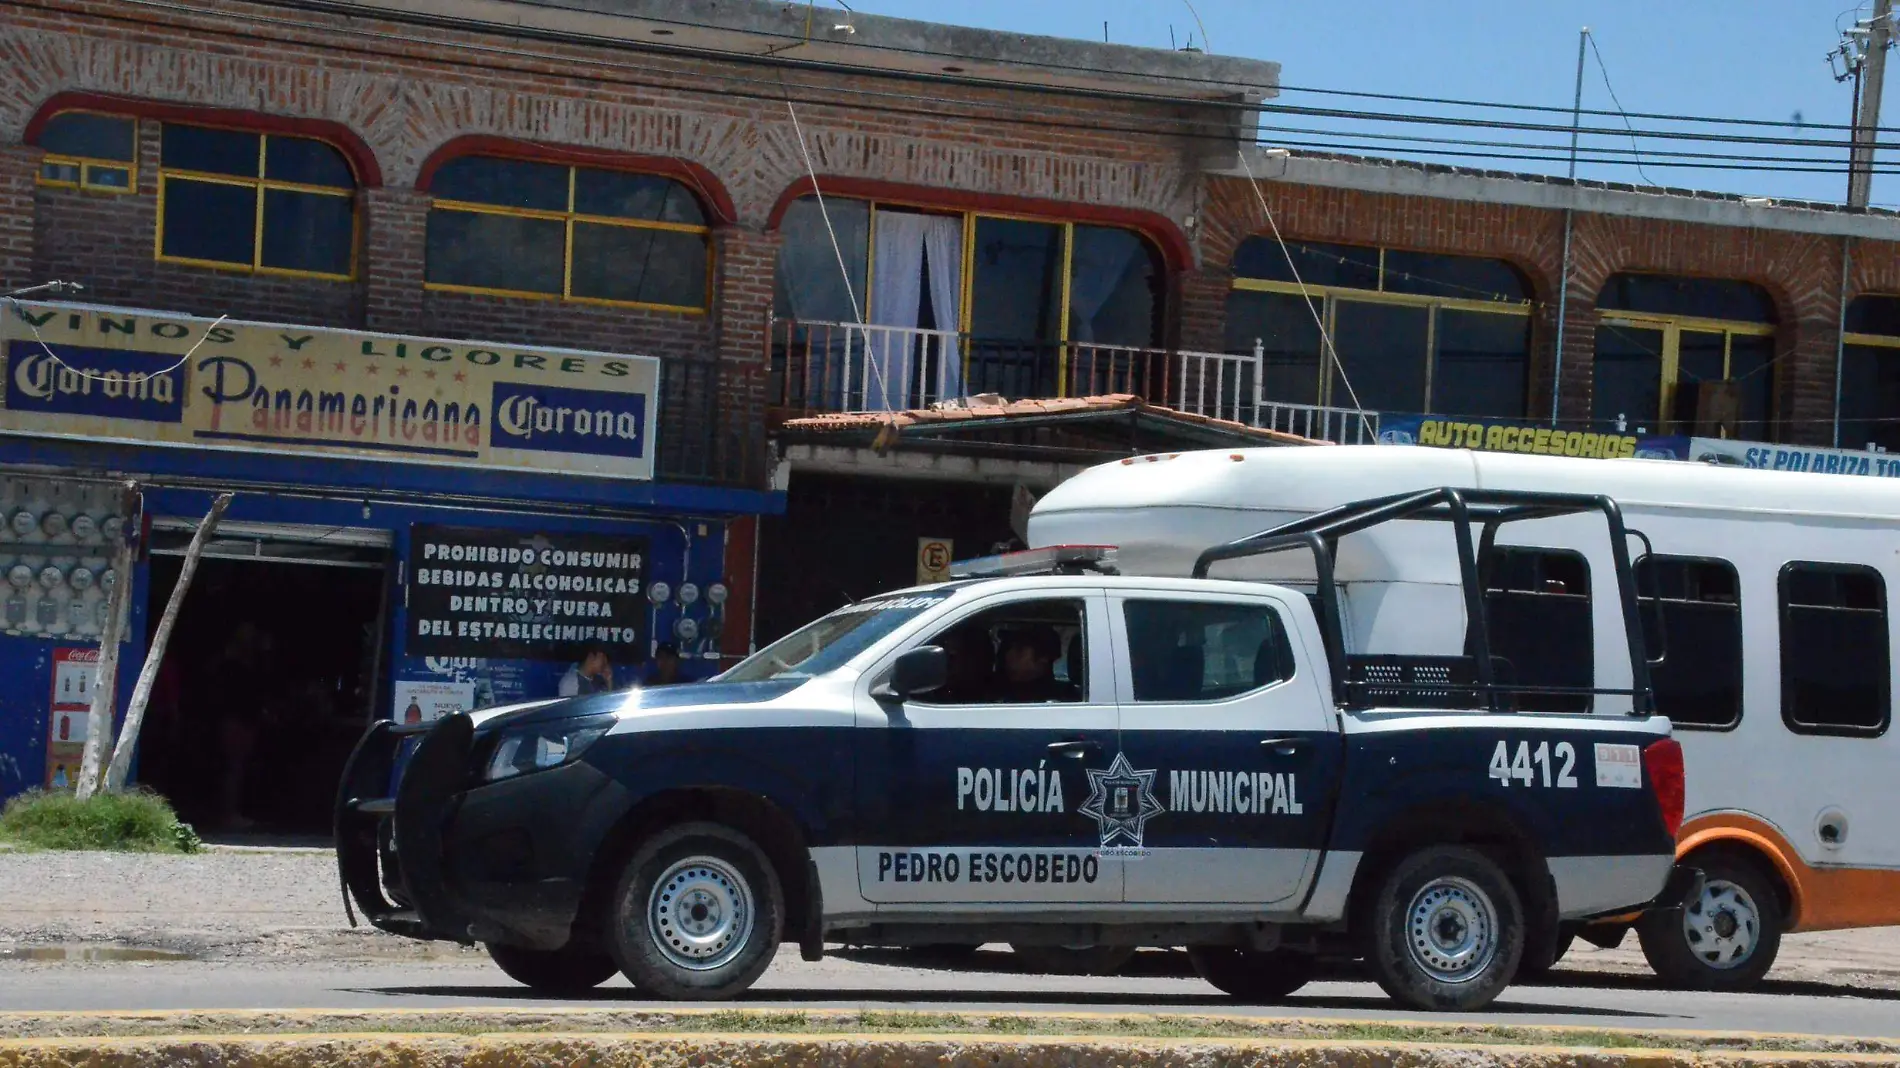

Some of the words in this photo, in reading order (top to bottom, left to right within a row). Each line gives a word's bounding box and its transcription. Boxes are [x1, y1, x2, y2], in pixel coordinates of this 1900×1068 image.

[21, 310, 236, 344] VINOS
[279, 333, 314, 351] Y
[361, 340, 630, 377] LICORES
[14, 354, 175, 404] Corona
[197, 356, 482, 446] Panamericana
[498, 394, 637, 441] Corona
[1419, 420, 1484, 448] AUTO
[1485, 425, 1637, 459] ACCESORIOS
[1773, 451, 1870, 475] POLARIZA
[424, 543, 535, 564] PROHIBIDO
[541, 550, 642, 569] CONSUMIR
[418, 569, 503, 588] BEBIDAS
[509, 572, 640, 594] ALCOHOLICAS
[450, 595, 528, 614] DENTRO
[534, 599, 548, 614] Y
[552, 600, 612, 618] FUERA
[418, 619, 452, 637] DEL
[458, 620, 635, 643] ESTABLECIMIENTO
[1489, 740, 1578, 788] 4412
[957, 759, 1064, 813] POLICÍA
[1170, 769, 1303, 815] MUNICIPAL
[878, 853, 960, 882] PEDRO
[969, 853, 1099, 883] ESCOBEDO
